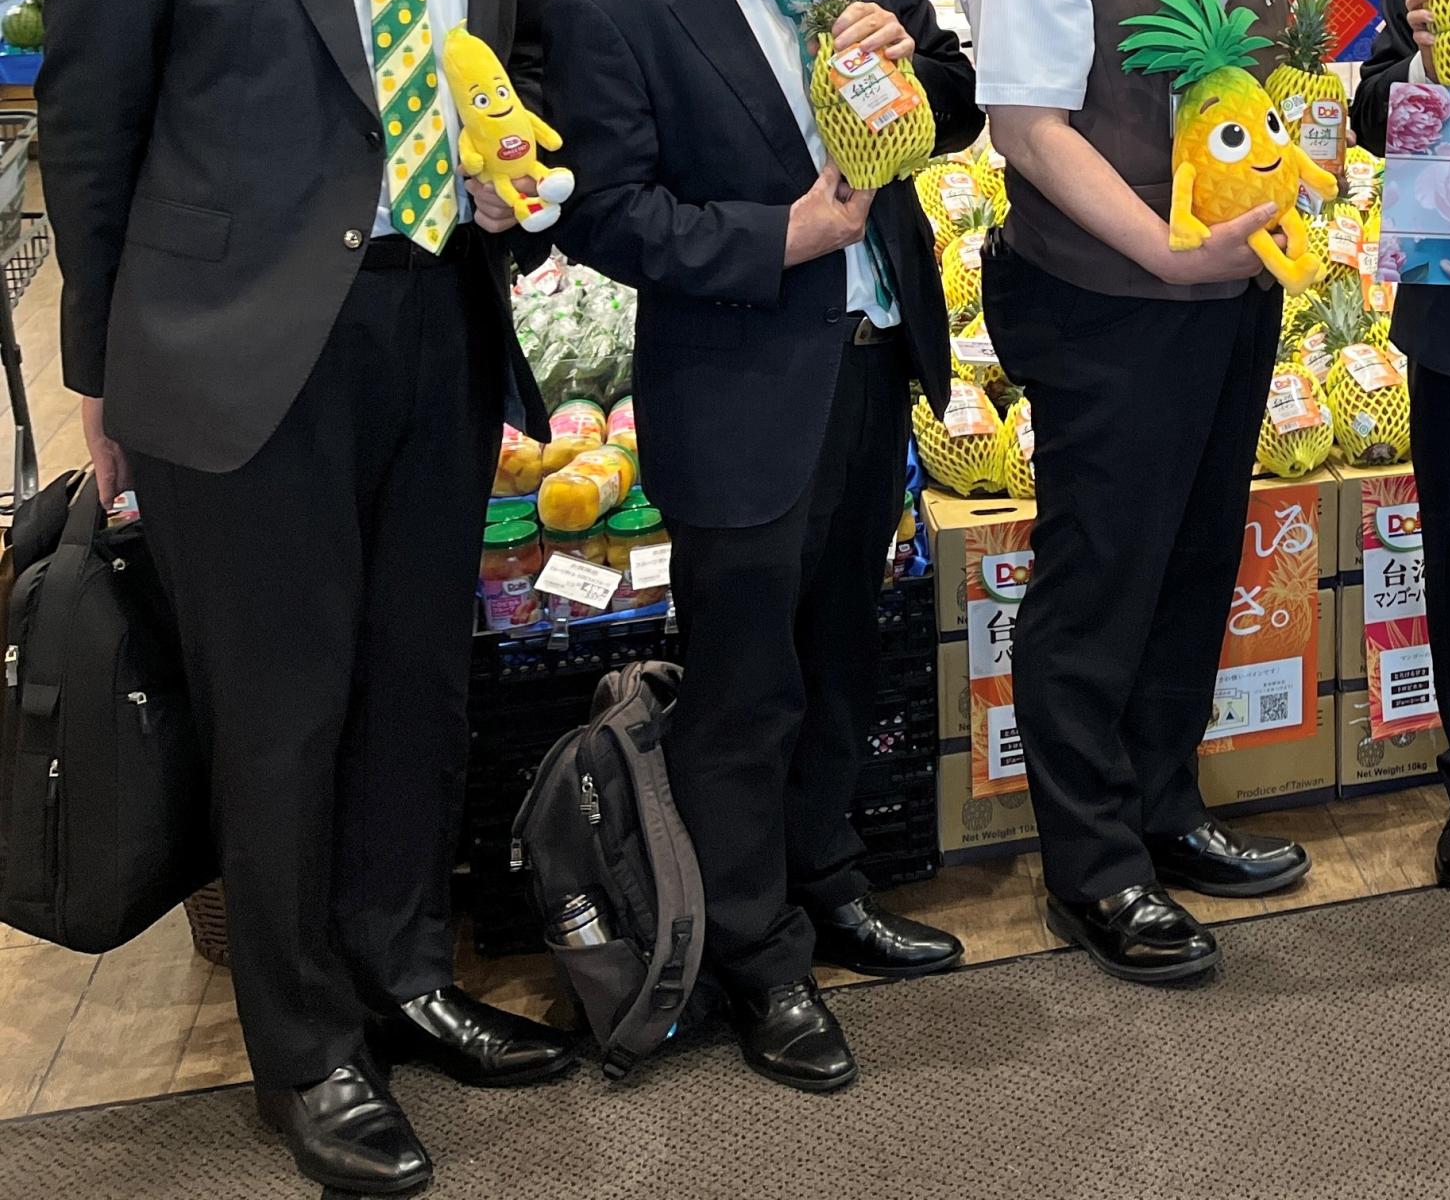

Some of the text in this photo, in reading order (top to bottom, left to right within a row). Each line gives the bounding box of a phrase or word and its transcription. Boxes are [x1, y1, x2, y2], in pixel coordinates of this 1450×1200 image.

[843, 50, 870, 71] Dole
[1318, 104, 1339, 116] Dole
[1388, 513, 1421, 536] Dol
[995, 560, 1033, 585] Dol
[1357, 761, 1428, 779] Net Weight 10kg
[1237, 777, 1325, 799] Produce of Taiwan
[961, 823, 1038, 844] Net Weight 10k
